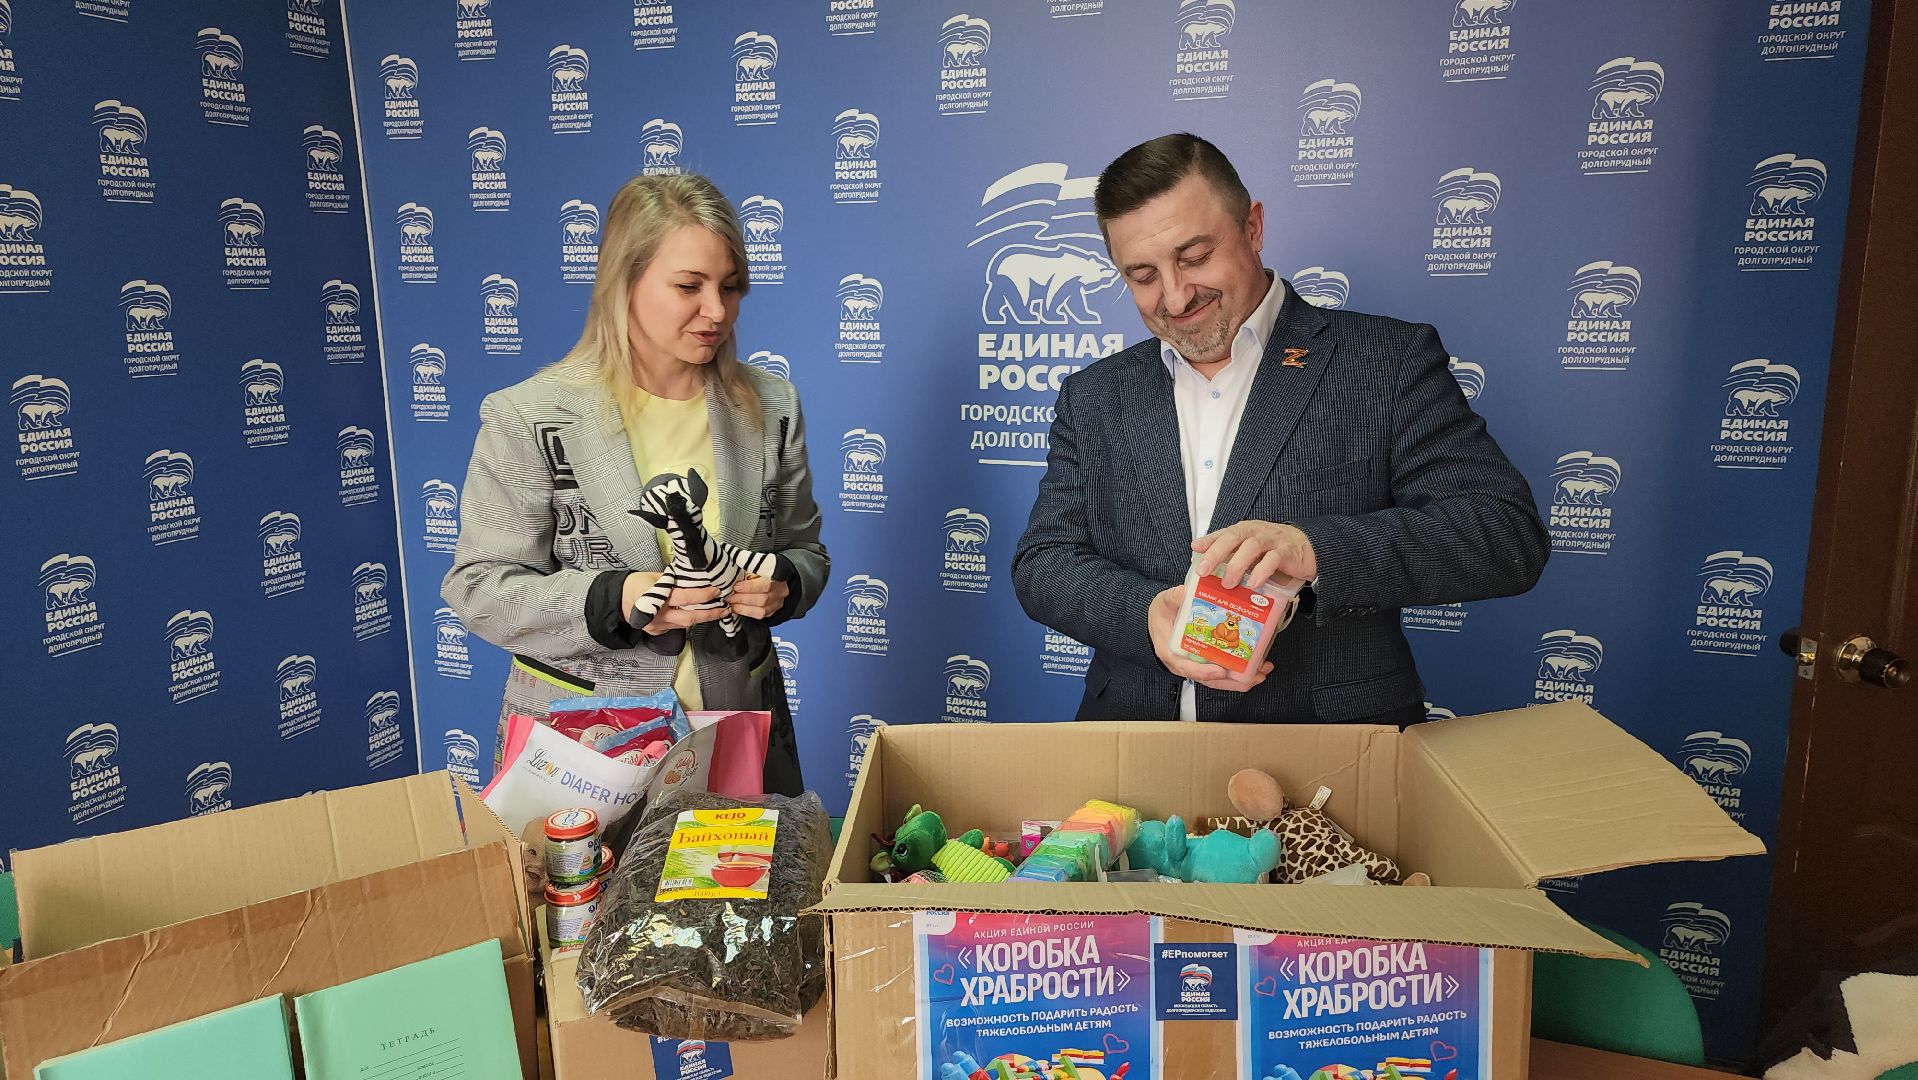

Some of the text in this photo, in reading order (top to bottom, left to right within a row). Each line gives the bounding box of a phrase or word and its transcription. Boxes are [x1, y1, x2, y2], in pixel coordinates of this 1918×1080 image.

[1769, 1, 1841, 16] ЕДИНАЯ
[1768, 14, 1840, 29] РОССИЯ
[1449, 26, 1511, 41] ЕДИНАЯ
[1757, 31, 1846, 43] ГОРОДСКОЙ ОКРУГ
[1448, 38, 1510, 53] РОССИЯ
[1760, 41, 1838, 55] ДОЛГОПРУДНЫЙ
[1176, 50, 1229, 63] ЕДИНАЯ
[1439, 54, 1516, 66] ГОРОДСКОЙ ОКРУГ
[1176, 60, 1228, 73] РОССИЯ
[1442, 64, 1510, 77] ДОЛГОПРУДНЫЙ
[941, 68, 987, 79] ЕДИНАЯ
[1169, 74, 1234, 85] ГОРОДСКОЙ ОКРУГ
[735, 81, 776, 92] ЕДИНАЯ
[941, 78, 987, 90] РОССИЯ
[1172, 84, 1229, 96] ДОЛГОПРУДНЫЙ
[551, 92, 588, 102] ЕДИНАЯ
[735, 91, 776, 102] РОССИЯ
[384, 100, 419, 109] ЕДИНАЯ
[552, 101, 589, 111] РОССИЯ
[385, 108, 420, 117] РОССИЯ
[1588, 119, 1654, 133] ЕДИНАЯ
[1298, 137, 1354, 149] ЕДИНАЯ
[1587, 131, 1652, 145] РОССИЯ
[1298, 147, 1353, 160] РОССИЯ
[1577, 148, 1629, 158] ГОРОДСКОЙ
[99, 154, 148, 166] ЕДИНАЯ
[834, 160, 877, 170] ЕДИНАЯ
[1580, 157, 1652, 169] ДОЛГОПРУДНЫЙ
[101, 165, 150, 177] РОССИЯ
[1290, 163, 1334, 172] ГОРОДСКОЙ
[835, 169, 878, 180] РОССИЯ
[1293, 171, 1354, 182] ДОЛГОПРУДНЫЙ
[1745, 217, 1815, 230] ЕДИНАЯ
[1433, 227, 1492, 238] ЕДИНАЯ
[1744, 229, 1813, 241] РОССИЯ
[1432, 237, 1491, 249] РОССИЯ
[224, 247, 266, 257] ЕДИНАЯ
[1424, 252, 1471, 261] ГОРОДСКОЙ
[1734, 246, 1789, 255] ГОРОДСКОЙ
[226, 258, 267, 266] РОССИЯ
[1427, 261, 1492, 271] ДОЛГОПРУДНЫЙ
[1737, 255, 1813, 266] ДОЛГОПРУДНЫЙ
[1567, 320, 1631, 331] ЕДИНАЯ
[126, 332, 173, 343] ЕДИНАЯ
[1566, 330, 1630, 342] РОССИЯ
[127, 341, 174, 353] РОССИЯ
[978, 333, 1124, 361] ЕДИНАЯ
[1557, 346, 1637, 357] ГОРОДСКОЙ ОКРУГ
[1561, 356, 1630, 364] ДОЛГОПРУДНЫЙ
[979, 364, 1080, 391] РОСС
[960, 404, 1057, 426] ГОРОДСКО
[1721, 418, 1789, 429] ЕДИНАЯ
[18, 428, 72, 443] ЕДИНАЯ
[970, 430, 1050, 450] ДОЛГОП
[1720, 430, 1788, 441] РОССИЯ
[20, 438, 73, 454] РОССИЯ
[1710, 444, 1764, 453] ГОРОДСКОЙ
[15, 451, 80, 466] ГОРОДСКОЙ ОКРУГ
[1713, 454, 1787, 464] ДОЛГОПРУДНЫЙ
[21, 461, 78, 476] ДОЛГОПРУДНЫЙ
[842, 473, 883, 482] ЕДИНАЯ
[843, 482, 884, 492] РОССИЯ
[1550, 505, 1612, 517] ЕДИНАЯ
[1549, 516, 1611, 528] РОССИЯ
[1590, 532, 1617, 540] ОКРУГ
[1551, 539, 1611, 549] ОЛГОПРУДНЫЙ
[263, 552, 301, 567] ЕДИНАЯ
[944, 552, 986, 563] ЕДИНАЯ
[264, 560, 302, 576] РОССИЯ
[944, 561, 986, 572] РОССИЯ
[45, 601, 97, 622] ЕДИНАЯ
[1697, 605, 1763, 618] ЕДИНАЯ
[47, 611, 98, 632] РОССИЯ
[1696, 616, 1761, 630] РОССИЯ
[1686, 629, 1767, 641] ГОРОДСКОЙ ОКРУГ
[1690, 639, 1761, 650] ДОЛГОПРУДНЫЙ
[70, 766, 119, 791] ЕДИНАЯ
[72, 775, 121, 800] РОССИЯ
[560, 771, 612, 804] DIAPER
[679, 831, 769, 844] Байховый
[974, 921, 1094, 940] АКЦИЯ ЕДИНОЙ РОССИИ
[1297, 938, 1332, 948] АКЦИЯ
[957, 934, 1100, 974] «КОРОБКА
[1161, 949, 1228, 959] #ЕРпомогает
[1660, 948, 1720, 967] ЕДИНАЯ
[1279, 942, 1428, 985] «КОРОБКА
[960, 965, 1131, 1007] ХРАБРОСТИ»
[1282, 972, 1459, 1020] ХРАБРОСТИ»
[947, 1003, 1138, 1028] ВОЗМОЖНОСТЬ ПОДАРИТЬ РАДОСТЬ
[976, 1019, 1112, 1038] ТЯЖЕЛОБОЛЬНЫМ ДЕТЯМ
[1268, 1010, 1467, 1040] ВОЗМОЖНОСТЬ ПОДАРИТЬ РАДОСТЬ
[380, 1027, 436, 1051] ТЕТРАДЬ
[1299, 1027, 1439, 1050] ТЯЖЕЛОБОЛЬНЫМ ДЕТЯМ
